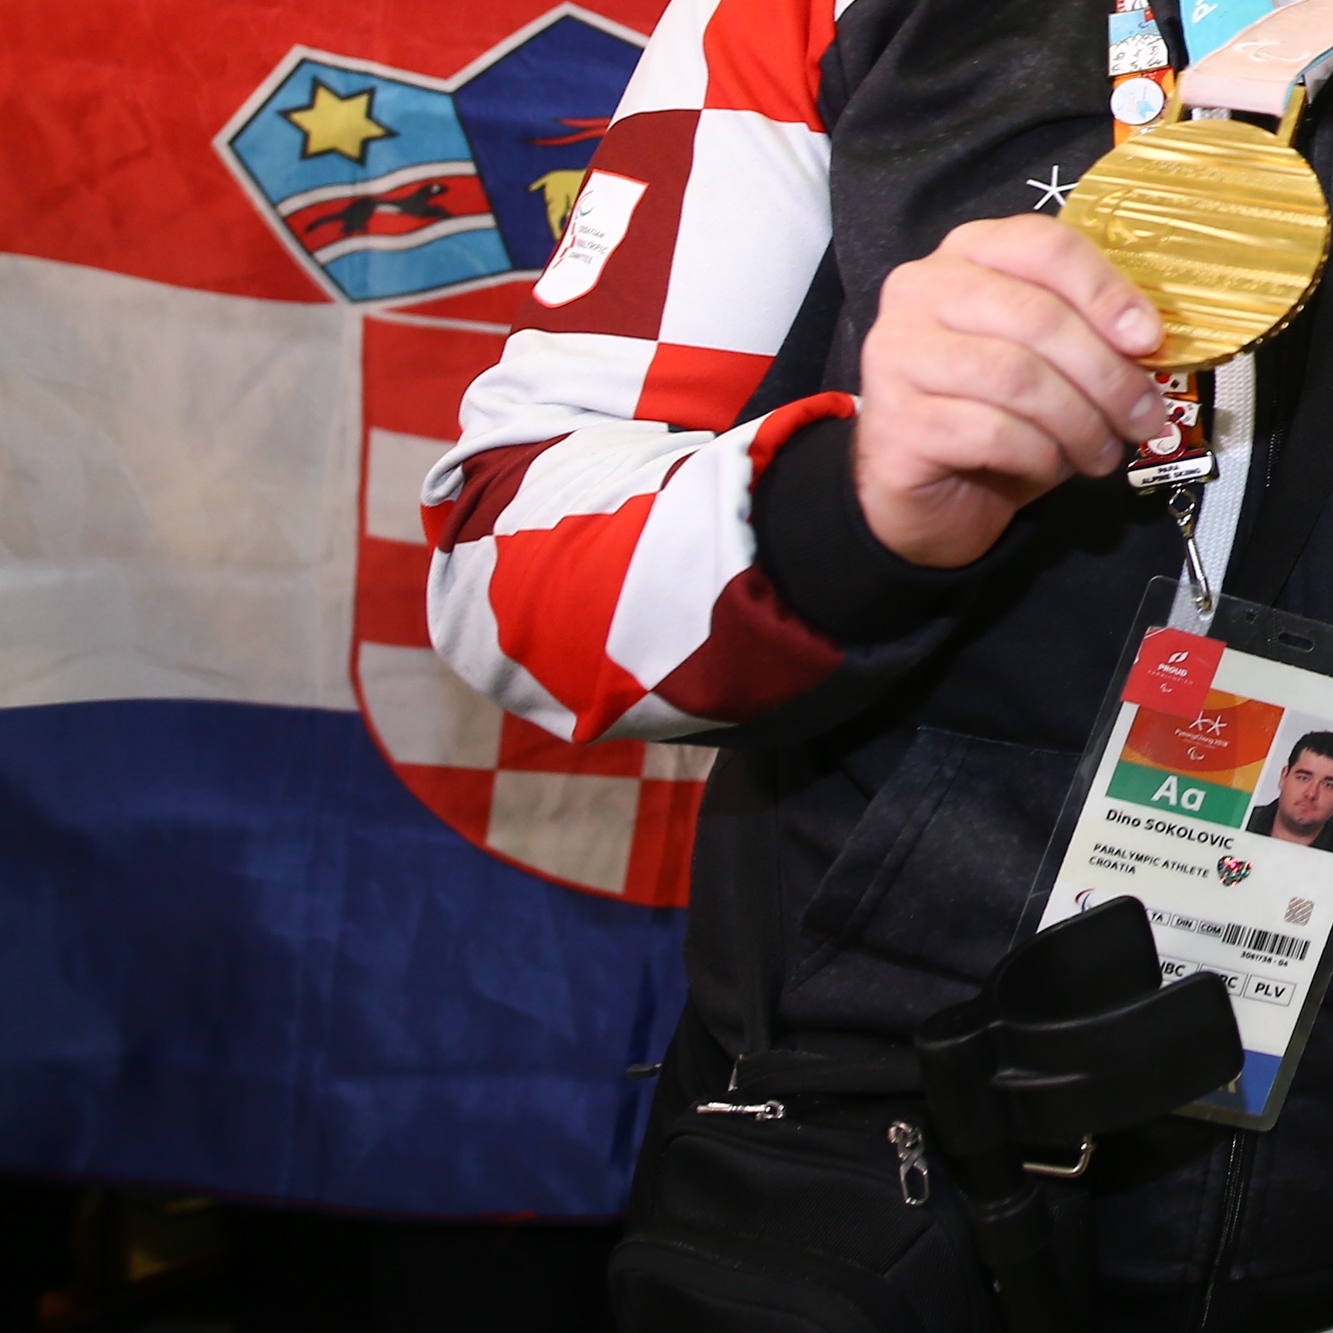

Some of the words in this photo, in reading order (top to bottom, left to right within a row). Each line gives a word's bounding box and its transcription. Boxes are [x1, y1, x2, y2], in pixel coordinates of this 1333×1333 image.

[1157, 662, 1188, 678] PROUD
[1151, 775, 1207, 812] Aa
[1105, 808, 1142, 828] Dino
[1144, 818, 1236, 850] SOKOLOVIC
[1089, 856, 1137, 875] CROATIA
[1092, 843, 1161, 867] PARALYMPIC
[1161, 859, 1211, 879] ATHLETE
[1254, 981, 1287, 999] PLV
